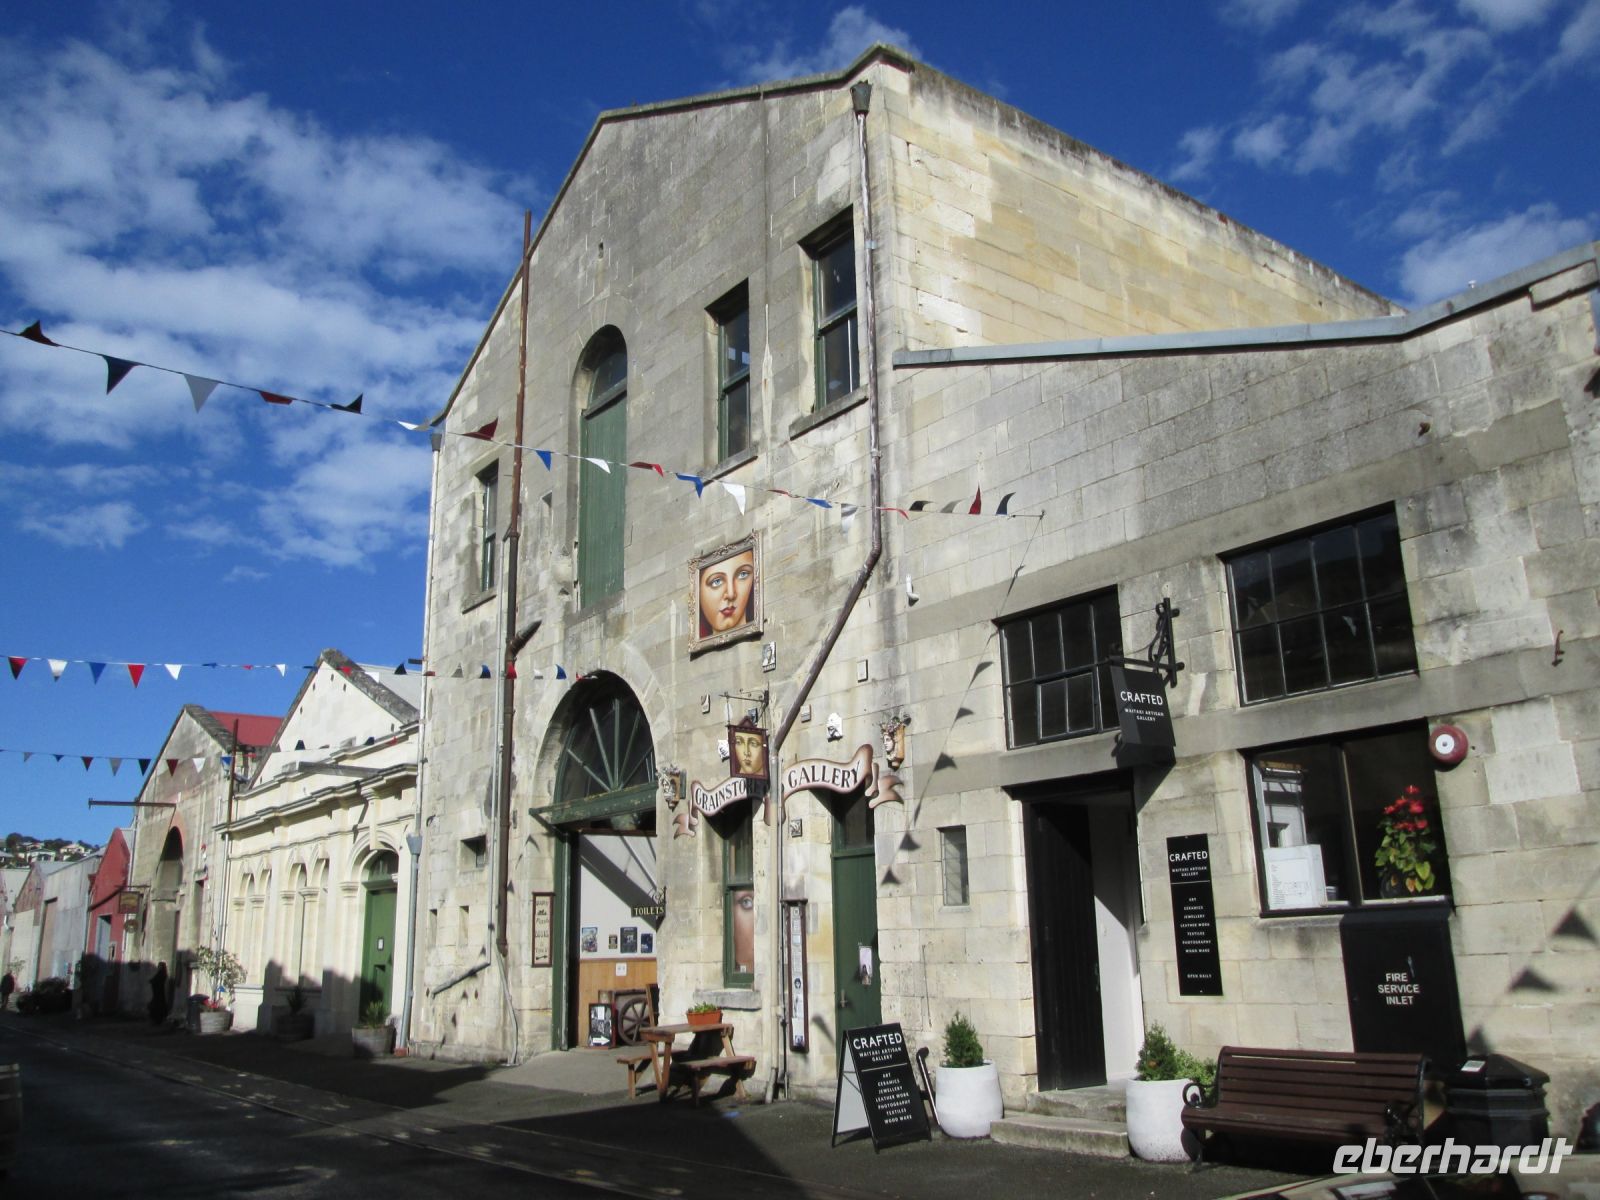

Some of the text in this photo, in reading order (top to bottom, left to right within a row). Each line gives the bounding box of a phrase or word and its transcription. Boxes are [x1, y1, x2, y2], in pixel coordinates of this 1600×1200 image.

[1120, 691, 1163, 706] CRAFTED
[788, 759, 861, 788] GALLERY
[1169, 851, 1208, 862] CRAFTED
[634, 906, 665, 916] TOILETS
[1385, 972, 1408, 982] FIRE
[1377, 984, 1420, 994] SERVICE
[1385, 995, 1414, 1005] INLET
[853, 1032, 902, 1050] CRAFTED
[859, 1050, 880, 1058] WAITAKI
[871, 1054, 893, 1062] GALLERY
[877, 1079, 900, 1087] CERAMICS
[878, 1086, 903, 1095] JEWELLERY
[875, 1094, 895, 1103] LEATHER
[877, 1099, 911, 1110] PHOTOGRAPHY
[886, 1108, 907, 1116] TEXTILES
